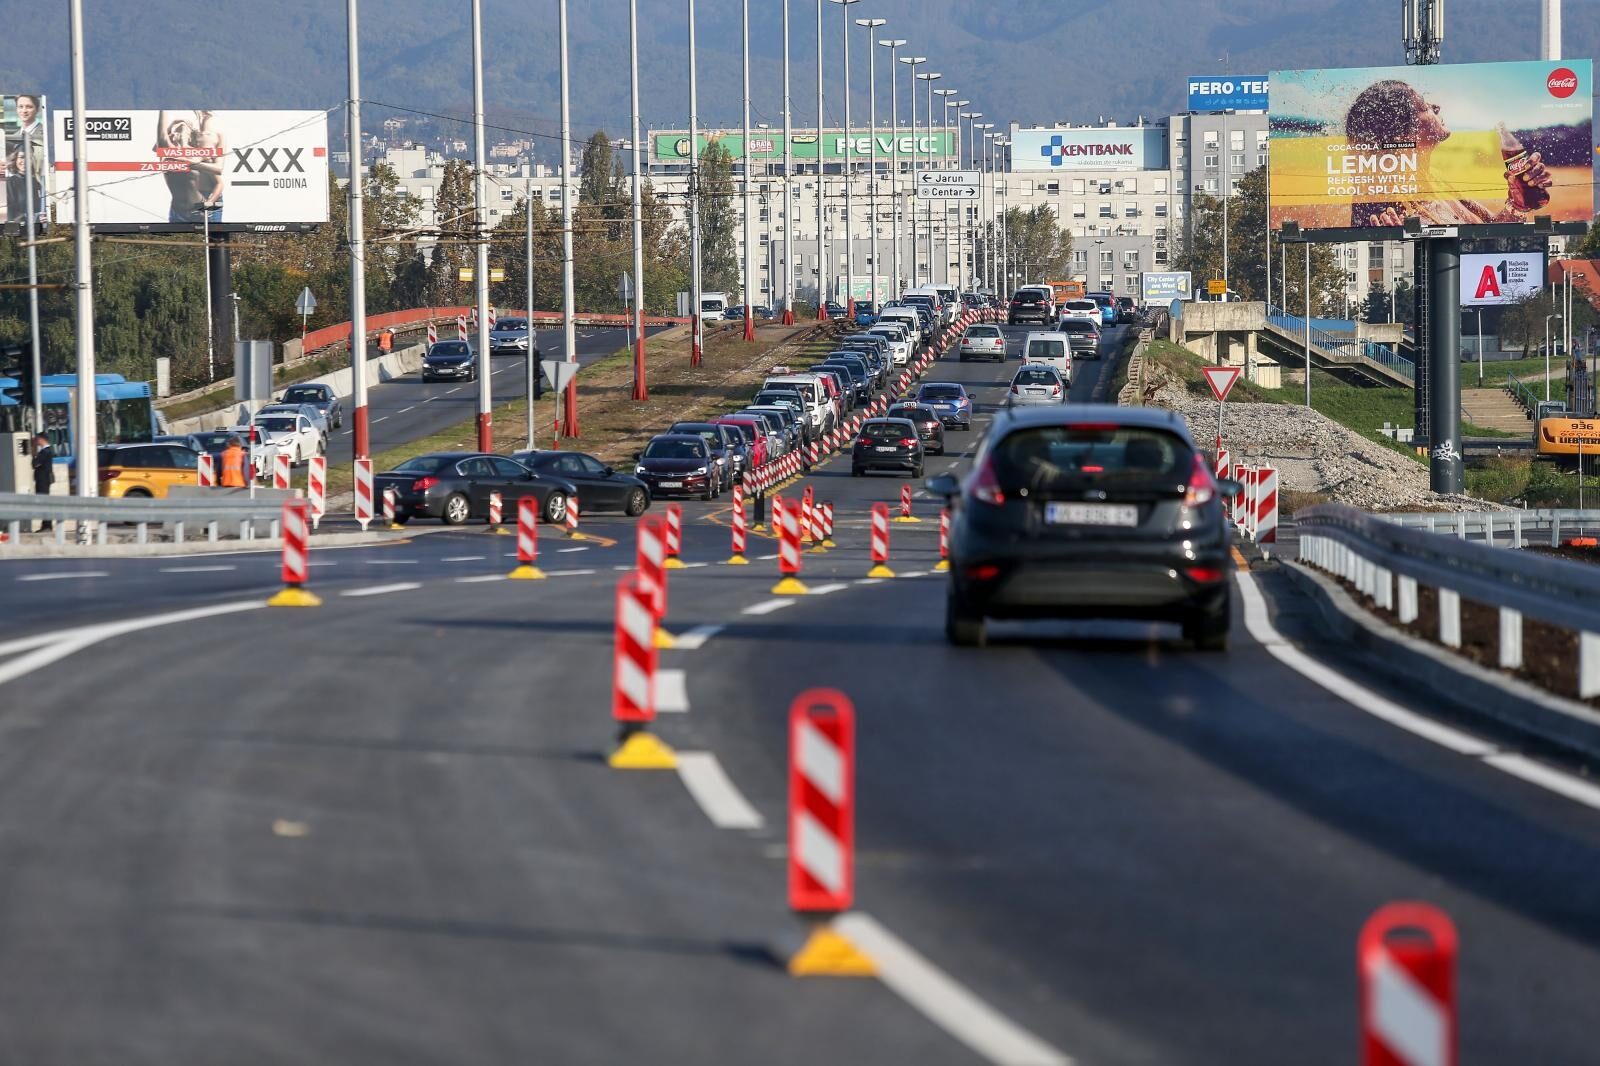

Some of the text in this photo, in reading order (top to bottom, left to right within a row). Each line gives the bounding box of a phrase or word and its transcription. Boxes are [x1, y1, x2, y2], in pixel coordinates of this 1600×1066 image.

[1189, 82, 1234, 95] FERO
[67, 119, 129, 132] Eopa 92
[836, 137, 938, 154] PEVEC
[1061, 144, 1133, 156] KENTBANK
[1327, 144, 1379, 152] COCA-COLA
[186, 148, 210, 157] BROJ
[212, 148, 217, 157] 1
[232, 148, 305, 173] XXX
[1327, 153, 1417, 174] LEMON
[141, 163, 188, 171] ZA JEANS
[273, 178, 307, 188] GODINA
[935, 174, 963, 183] Jarun
[1327, 174, 1416, 185] REFRESH WITH A
[931, 188, 962, 196] Centar
[1327, 184, 1417, 196] COOL SPLASH
[1475, 260, 1507, 298] A1
